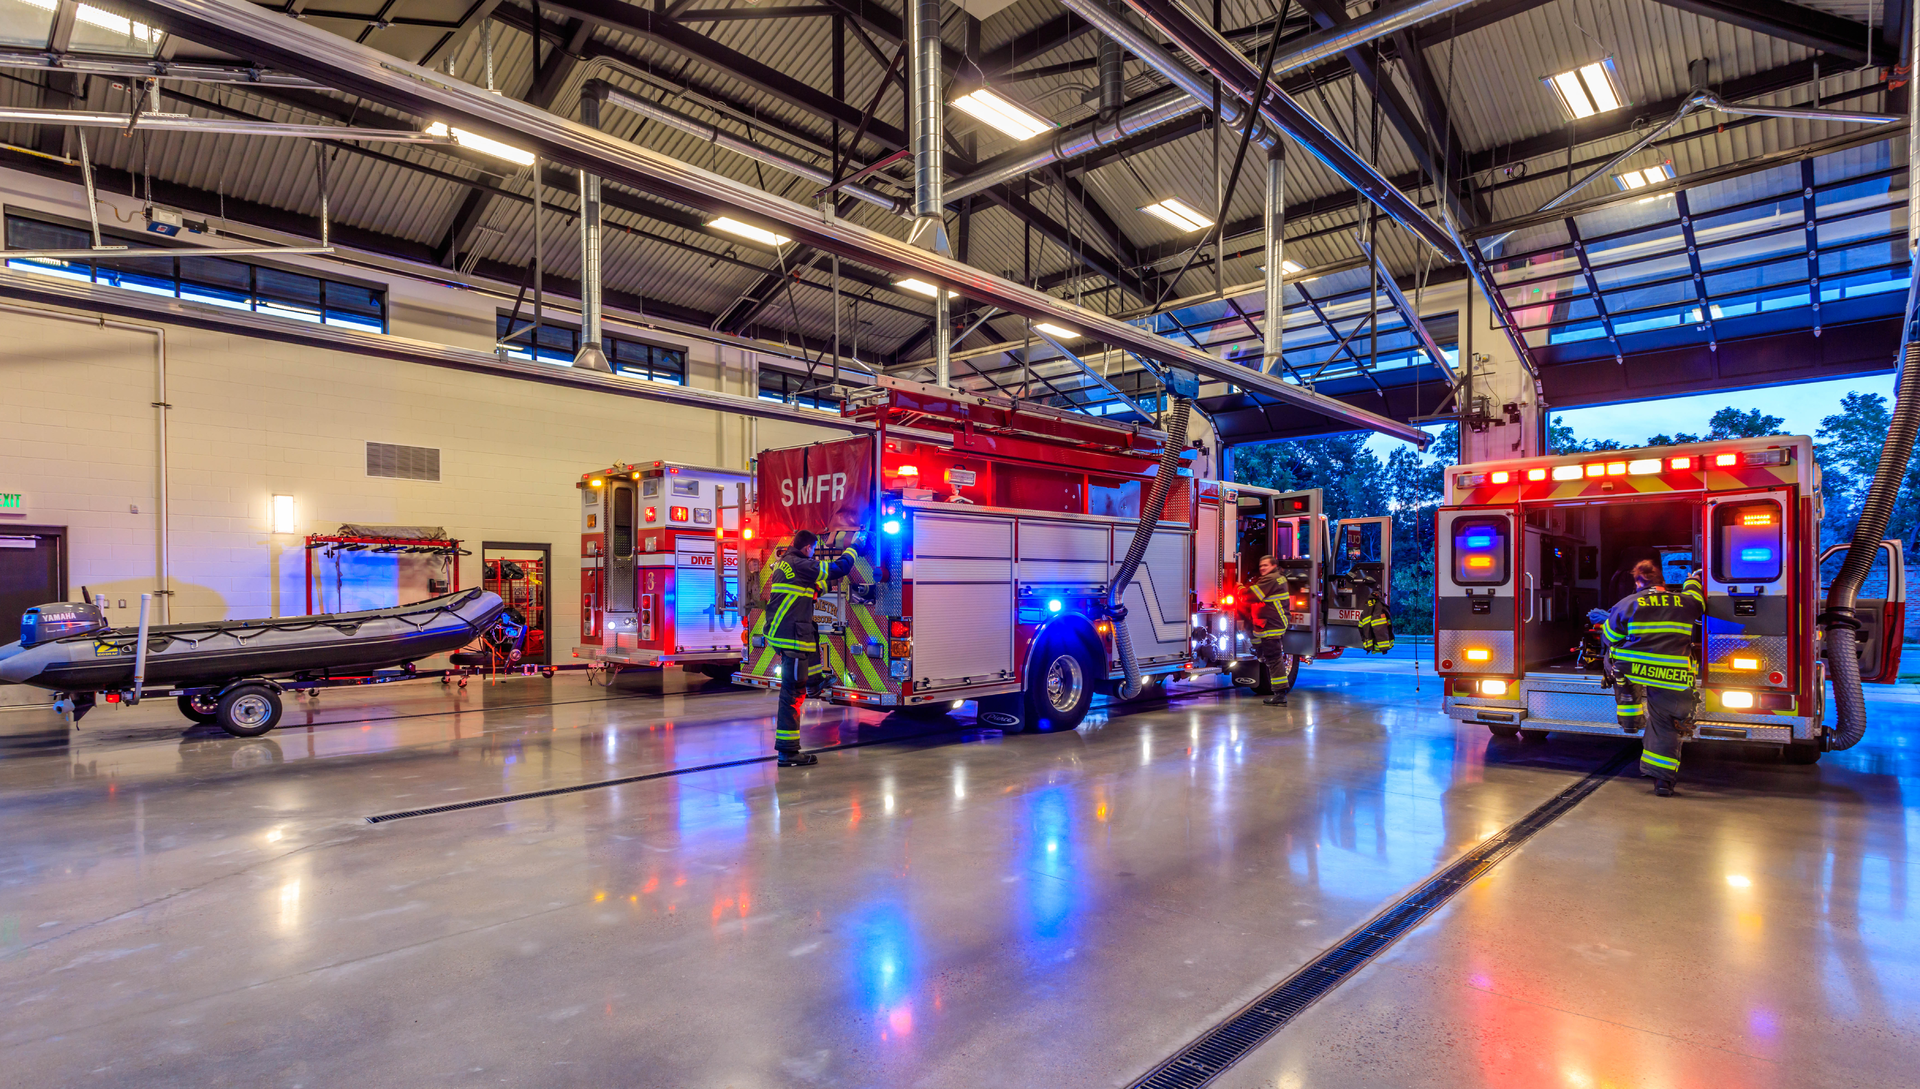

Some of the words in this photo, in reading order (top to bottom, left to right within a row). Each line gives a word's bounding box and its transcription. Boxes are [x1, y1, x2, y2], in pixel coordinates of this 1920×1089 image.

[781, 472, 847, 507] SMFR
[691, 556, 712, 565] DIVE
[42, 612, 77, 623] YAMAHA
[702, 604, 738, 633] 10
[1338, 610, 1361, 620] SMFR
